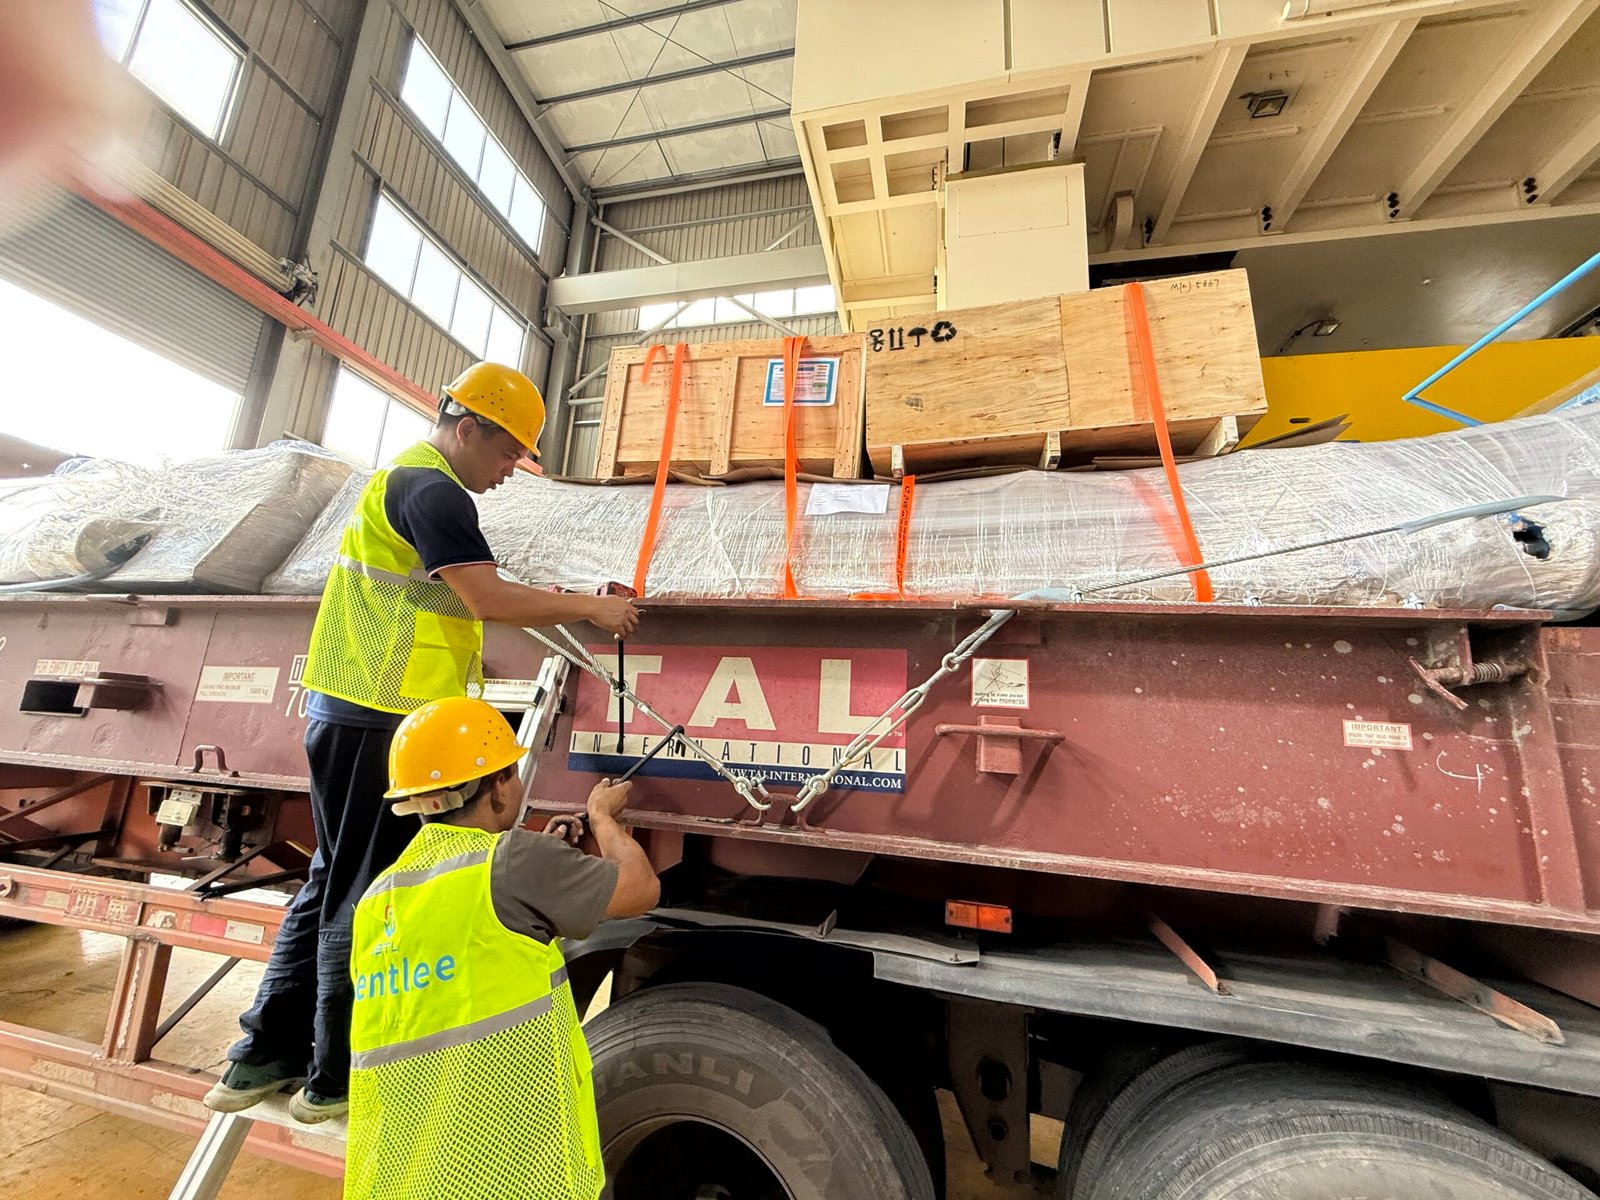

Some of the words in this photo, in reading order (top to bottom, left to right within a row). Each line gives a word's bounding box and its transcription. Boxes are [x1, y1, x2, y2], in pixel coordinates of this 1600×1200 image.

[222, 671, 256, 681] IMPORTANT
[590, 654, 892, 734] TAL
[1351, 723, 1402, 733] IMPORTANT
